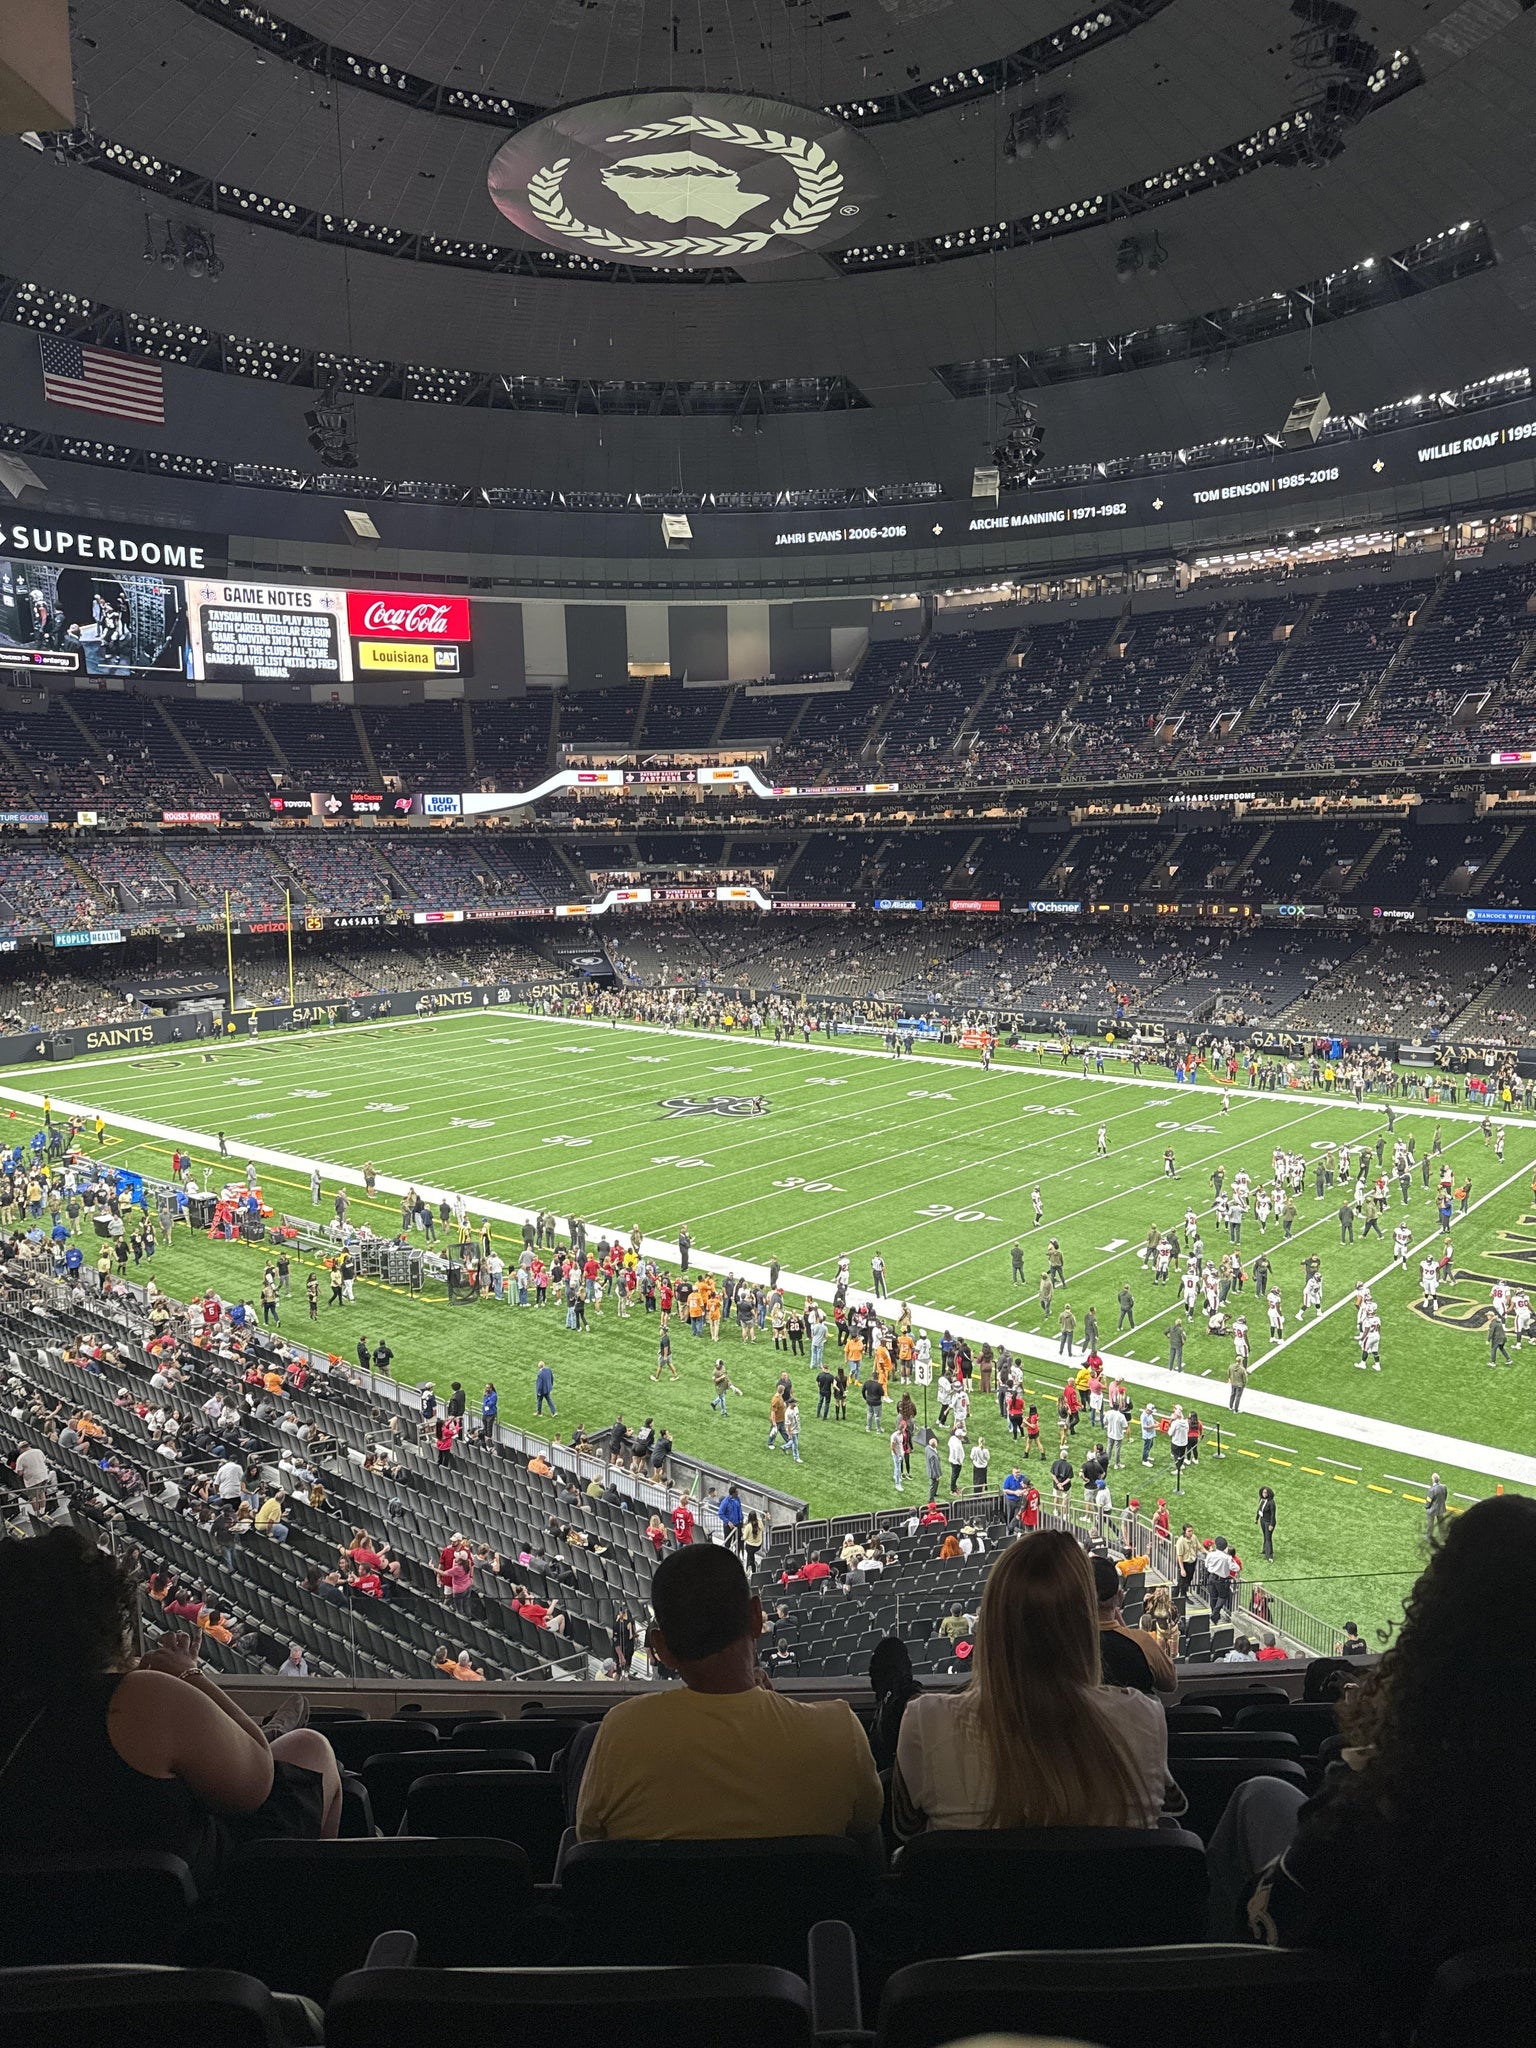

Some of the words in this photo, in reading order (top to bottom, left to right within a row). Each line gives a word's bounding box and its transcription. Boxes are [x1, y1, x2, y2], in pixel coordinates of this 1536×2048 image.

[1418, 442, 1462, 463] WILLIE
[1463, 431, 1499, 452] ROAF
[1193, 490, 1220, 504] TOM
[1221, 480, 1269, 500] BENSON
[1277, 467, 1339, 489] 1985-2018
[969, 516, 1010, 531] ARCHIE
[1011, 510, 1065, 527] MANNING
[1072, 503, 1127, 519] 1971-1982
[775, 532, 806, 546] JAHRI
[808, 529, 842, 543] EVANS
[848, 525, 907, 540] 2006-2016
[12, 525, 206, 570] SUPERDOME
[1456, 547, 1483, 556] WWL
[223, 587, 264, 604] GAME
[268, 590, 312, 607] NOTES
[208, 610, 242, 622] TAYSOM
[243, 612, 261, 623] HILL
[261, 613, 282, 625] WILL
[282, 614, 302, 626] PLAY
[303, 616, 313, 626] IN
[313, 617, 329, 627] HIS
[364, 601, 452, 633] Coca-Cola
[208, 621, 234, 632] 109TH
[234, 622, 265, 634] CAREER
[265, 625, 300, 636] REGULAR
[301, 627, 331, 638] SEASON
[211, 632, 238, 644] GAME,
[238, 634, 271, 645] MOVING
[271, 636, 291, 646] INTO
[292, 637, 298, 647] A
[299, 637, 313, 647] TIE
[313, 638, 329, 648] FOR
[236, 644, 248, 655] ON
[249, 645, 264, 656] THE
[265, 646, 292, 657] CLUB'S
[293, 648, 328, 659] ALL-TIME
[205, 653, 234, 665] GAMES
[234, 655, 264, 666] PLAYED
[265, 656, 284, 667] LIST
[284, 657, 305, 668] WITH
[306, 658, 317, 669] CB
[318, 659, 338, 670] FRED
[372, 650, 429, 663] Louisiana
[435, 651, 457, 666] CAT
[254, 666, 290, 678] THOMAS.
[1304, 762, 1336, 771] SAINTS
[1371, 759, 1404, 768] SAINTS
[1443, 756, 1478, 765] SAINTS
[1177, 769, 1206, 777] SAINTS
[1239, 766, 1269, 774] SAINTS
[1061, 775, 1087, 783] SAINTS
[1454, 784, 1486, 792] SAINTS
[431, 797, 454, 805] BUD
[1168, 794, 1209, 803] CAESARS
[1209, 792, 1256, 801] SUPERDOME
[352, 802, 380, 812] 33:14
[427, 804, 457, 812] LIGHT
[19, 814, 48, 822] GLOBAL
[163, 813, 189, 821] ROUSES
[190, 813, 220, 821] MARKETS
[891, 901, 917, 909] Allstate
[1037, 902, 1080, 913] Ochsner
[1327, 907, 1358, 915] SAINTS
[1383, 909, 1415, 920] entergy
[249, 921, 293, 933] verizon
[307, 918, 321, 929] 25
[334, 917, 380, 927] CAESARS
[131, 927, 161, 937] SAINTS
[56, 933, 90, 946] PEOPLES
[91, 931, 120, 942] HEALTH
[0, 939, 17, 951] er
[139, 982, 219, 996] SAINTS
[87, 1025, 153, 1049] SAINTS
[541, 1134, 593, 1147] 50
[651, 1155, 705, 1168] 40
[772, 1176, 834, 1193] 30
[914, 1204, 987, 1223] 20
[789, 1322, 800, 1332] 20
[918, 1366, 925, 1380] 3
[675, 1518, 686, 1531] 13
